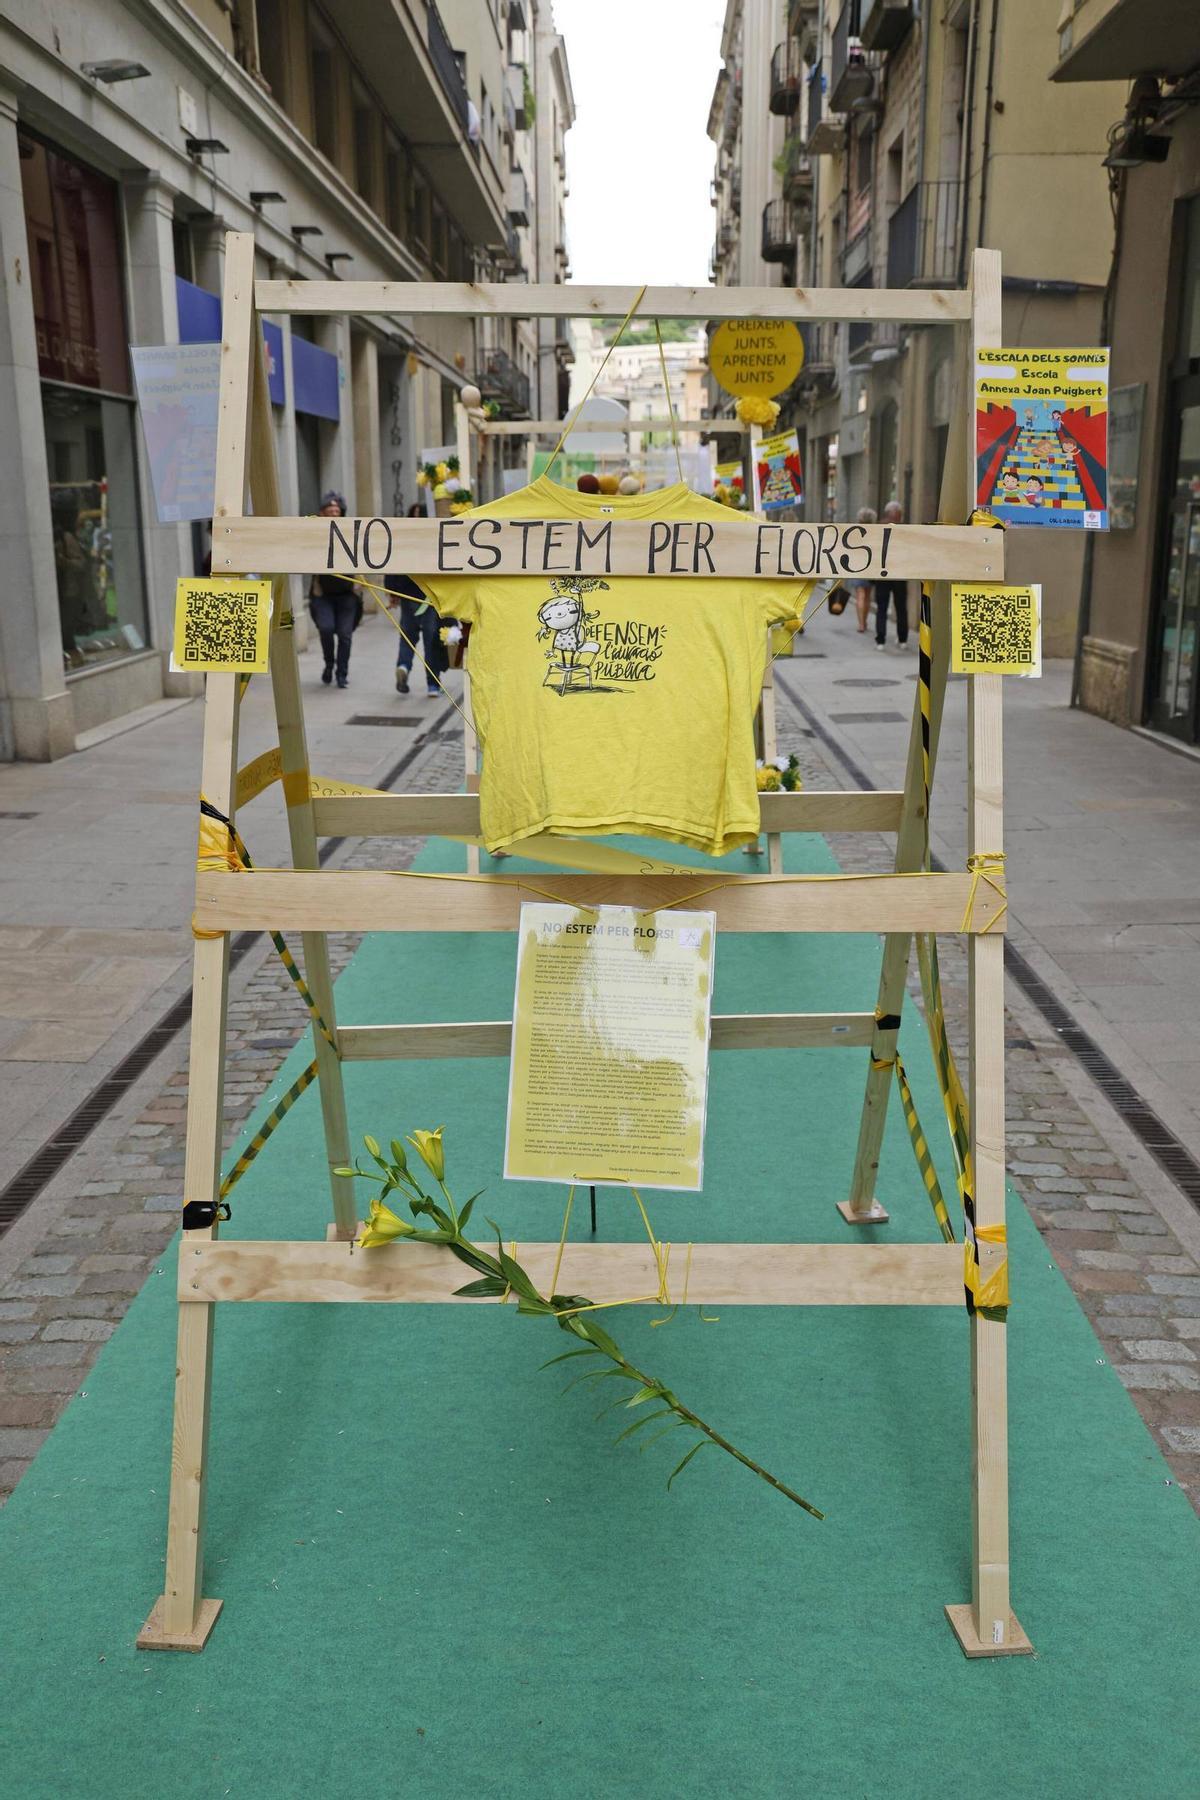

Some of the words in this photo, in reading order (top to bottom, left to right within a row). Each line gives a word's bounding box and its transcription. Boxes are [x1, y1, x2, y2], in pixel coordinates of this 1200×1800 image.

[727, 320, 785, 332] CREIXEM
[723, 354, 786, 367] APRENEM
[978, 352, 1030, 362] L'ESCALA
[1031, 354, 1061, 363] DELS
[734, 371, 775, 384] JUNTS
[1021, 369, 1059, 379] Escola
[980, 383, 1020, 394] Annexa
[1023, 385, 1051, 395] Joan
[1053, 386, 1103, 397] Puigbert
[327, 518, 392, 570] NO
[438, 519, 613, 573] ESTEM
[647, 521, 716, 574] PER
[754, 525, 892, 577] FLORS!
[585, 621, 660, 647] DEFENSEM
[543, 922, 562, 933] NO
[565, 923, 604, 935] ESTEM
[607, 926, 630, 937] PER
[633, 927, 675, 939] FLORS!
